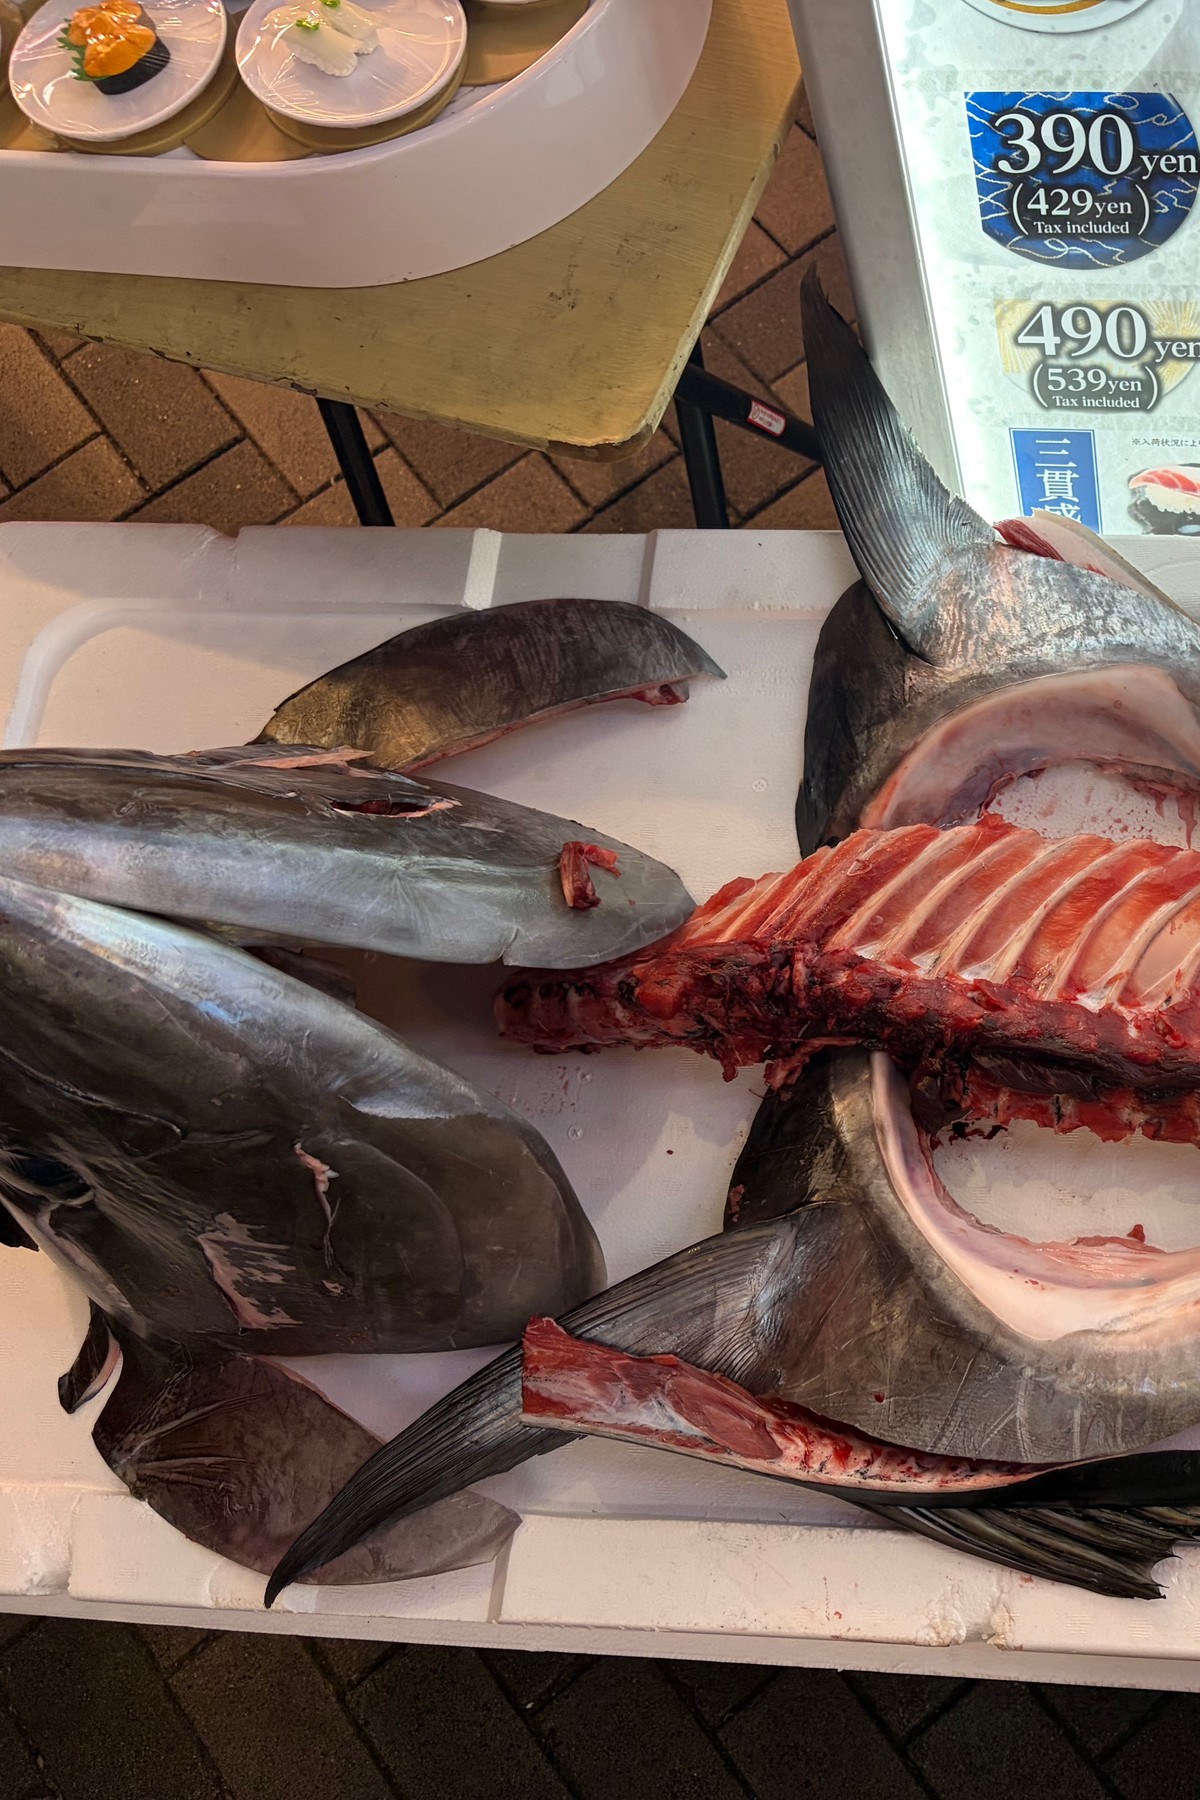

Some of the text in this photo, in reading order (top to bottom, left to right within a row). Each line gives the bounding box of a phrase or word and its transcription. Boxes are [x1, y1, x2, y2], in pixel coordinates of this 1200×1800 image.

[995, 113, 1199, 180] 390 yen
[1034, 221, 1129, 234] Tax included
[1017, 305, 1147, 358] 490
[1052, 396, 1140, 408] Tax included
